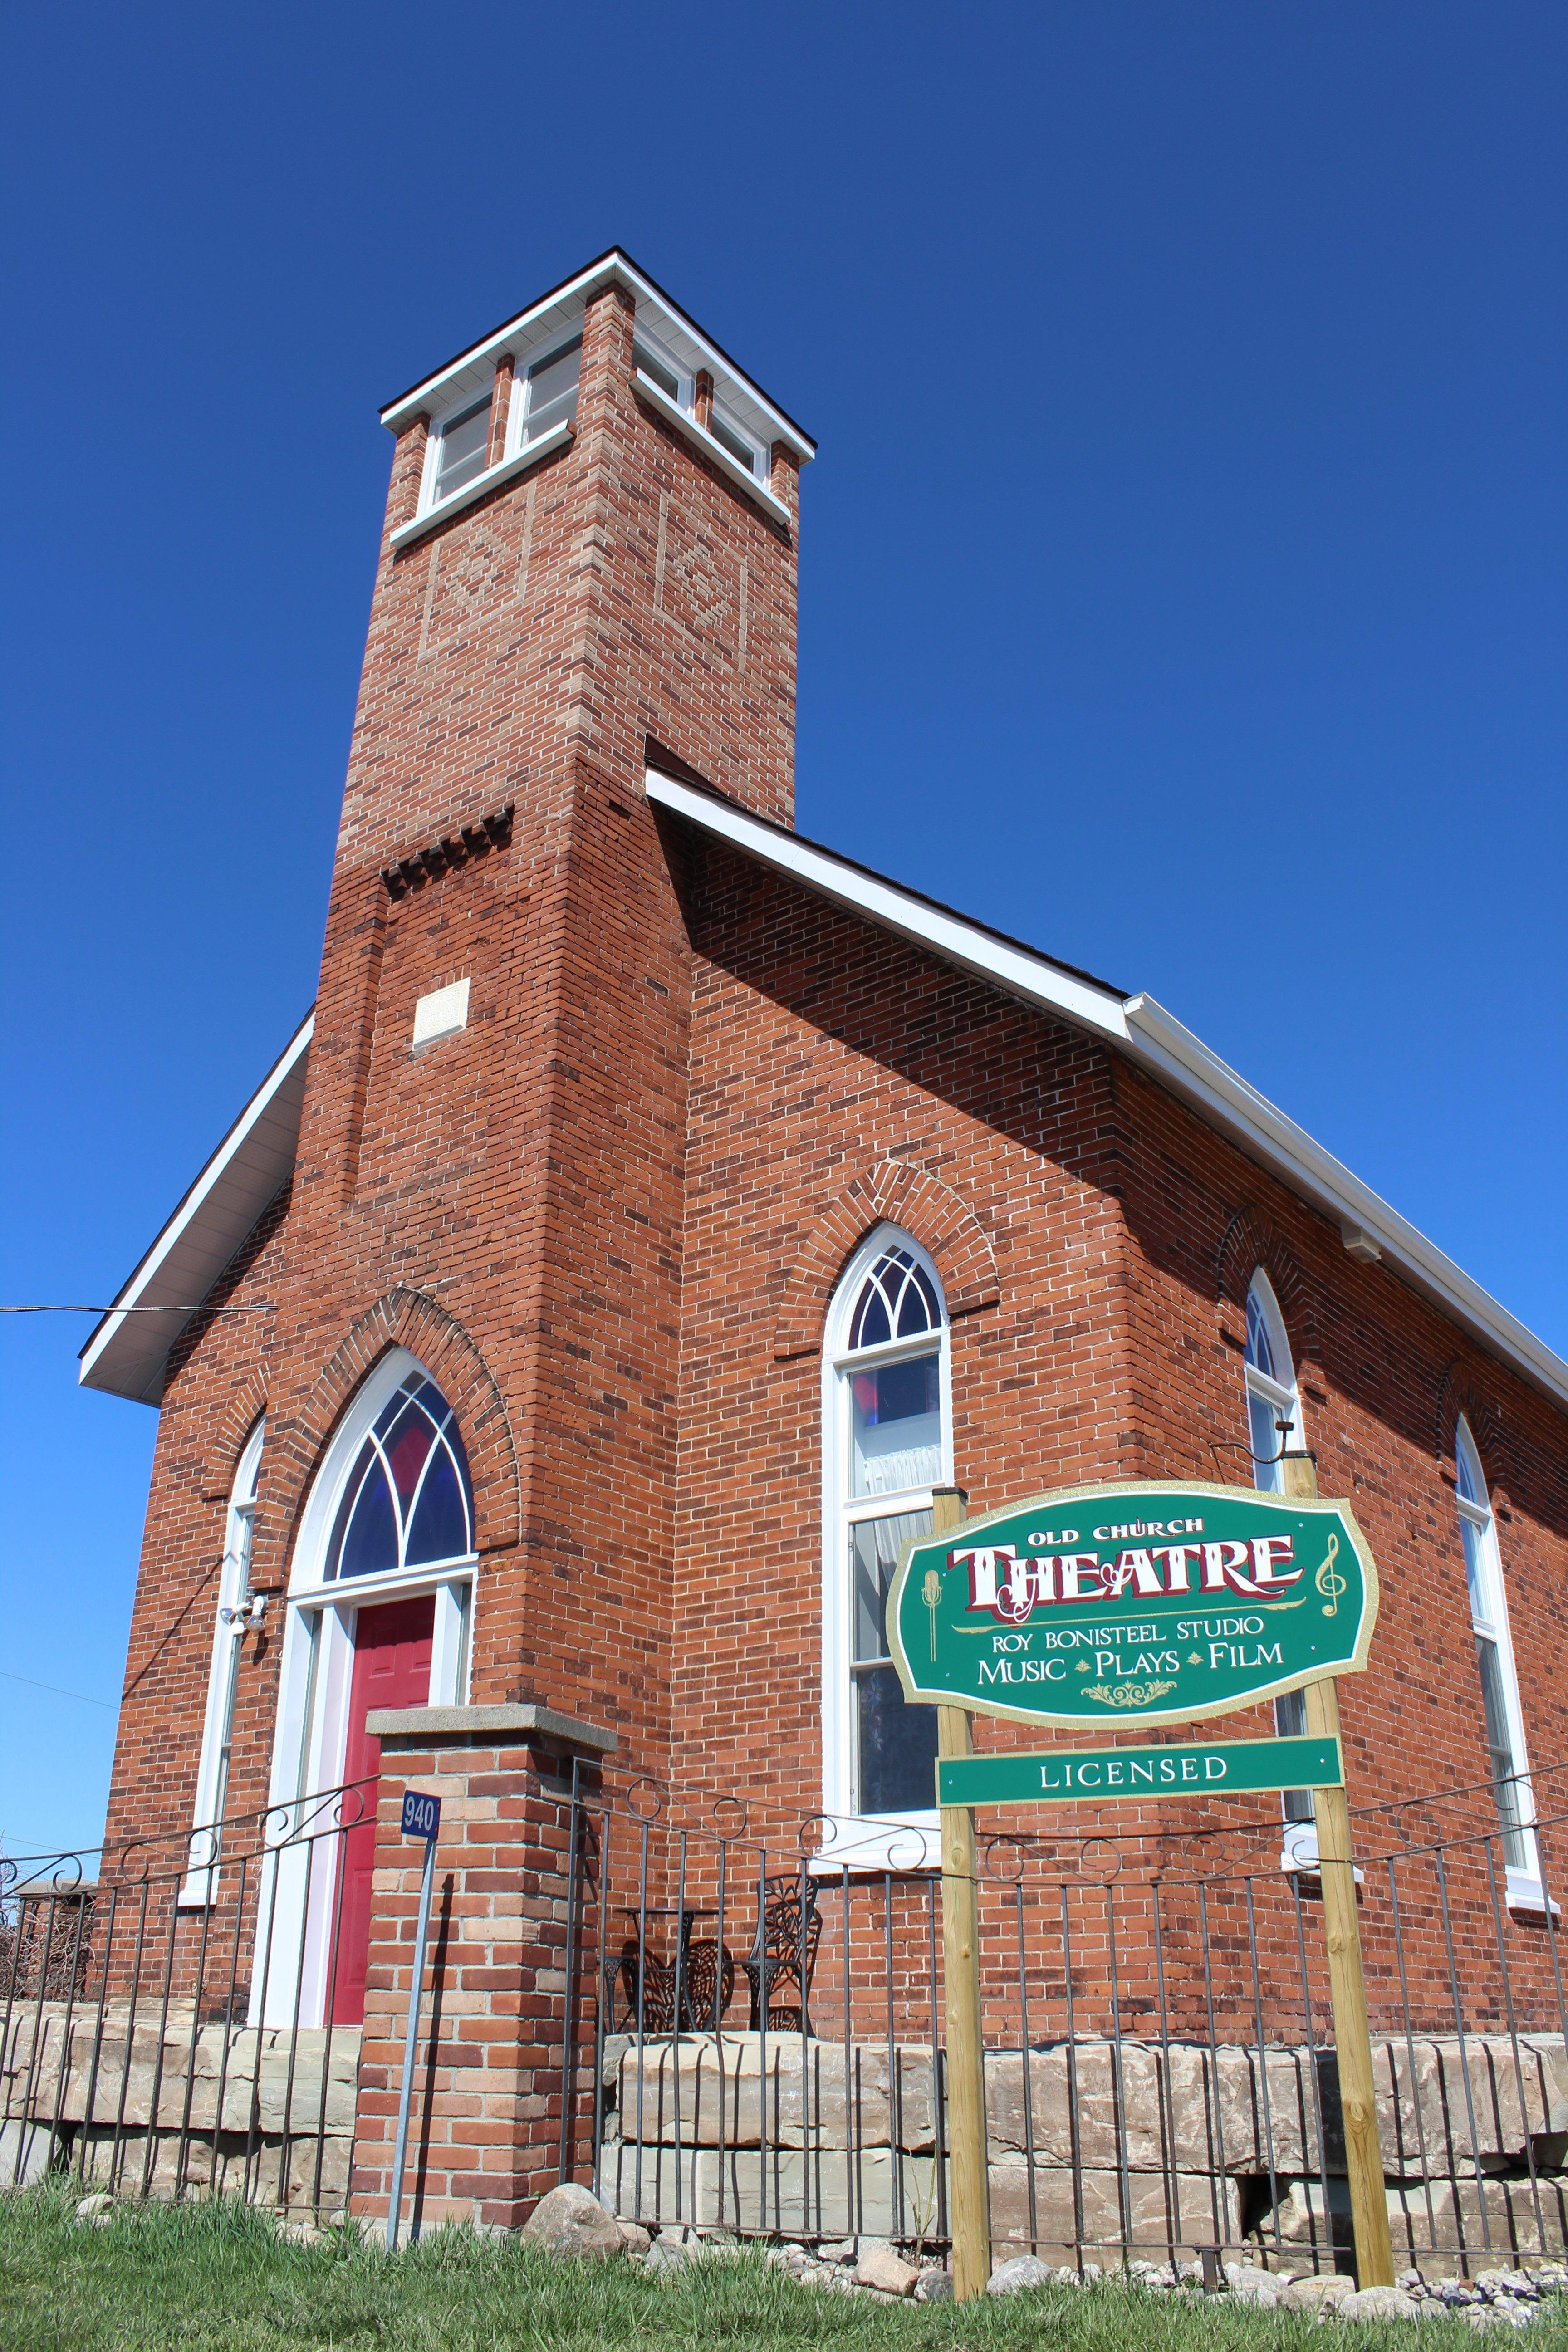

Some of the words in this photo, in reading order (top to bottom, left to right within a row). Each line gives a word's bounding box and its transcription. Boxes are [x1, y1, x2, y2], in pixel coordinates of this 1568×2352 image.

[1027, 1529, 1079, 1546] OLD
[1092, 1517, 1204, 1540] CHURCH
[950, 1534, 1304, 1623] THEATRE
[992, 1633, 1033, 1653] ROY
[1045, 1624, 1166, 1649] BONISTEEL
[1177, 1616, 1264, 1640] STUDIO
[977, 1658, 1066, 1685] MUSIC
[1094, 1650, 1180, 1677] PLAYS
[1207, 1642, 1284, 1669] FILM
[1039, 1756, 1227, 1788] LICENSED
[405, 1796, 434, 1831] 940
